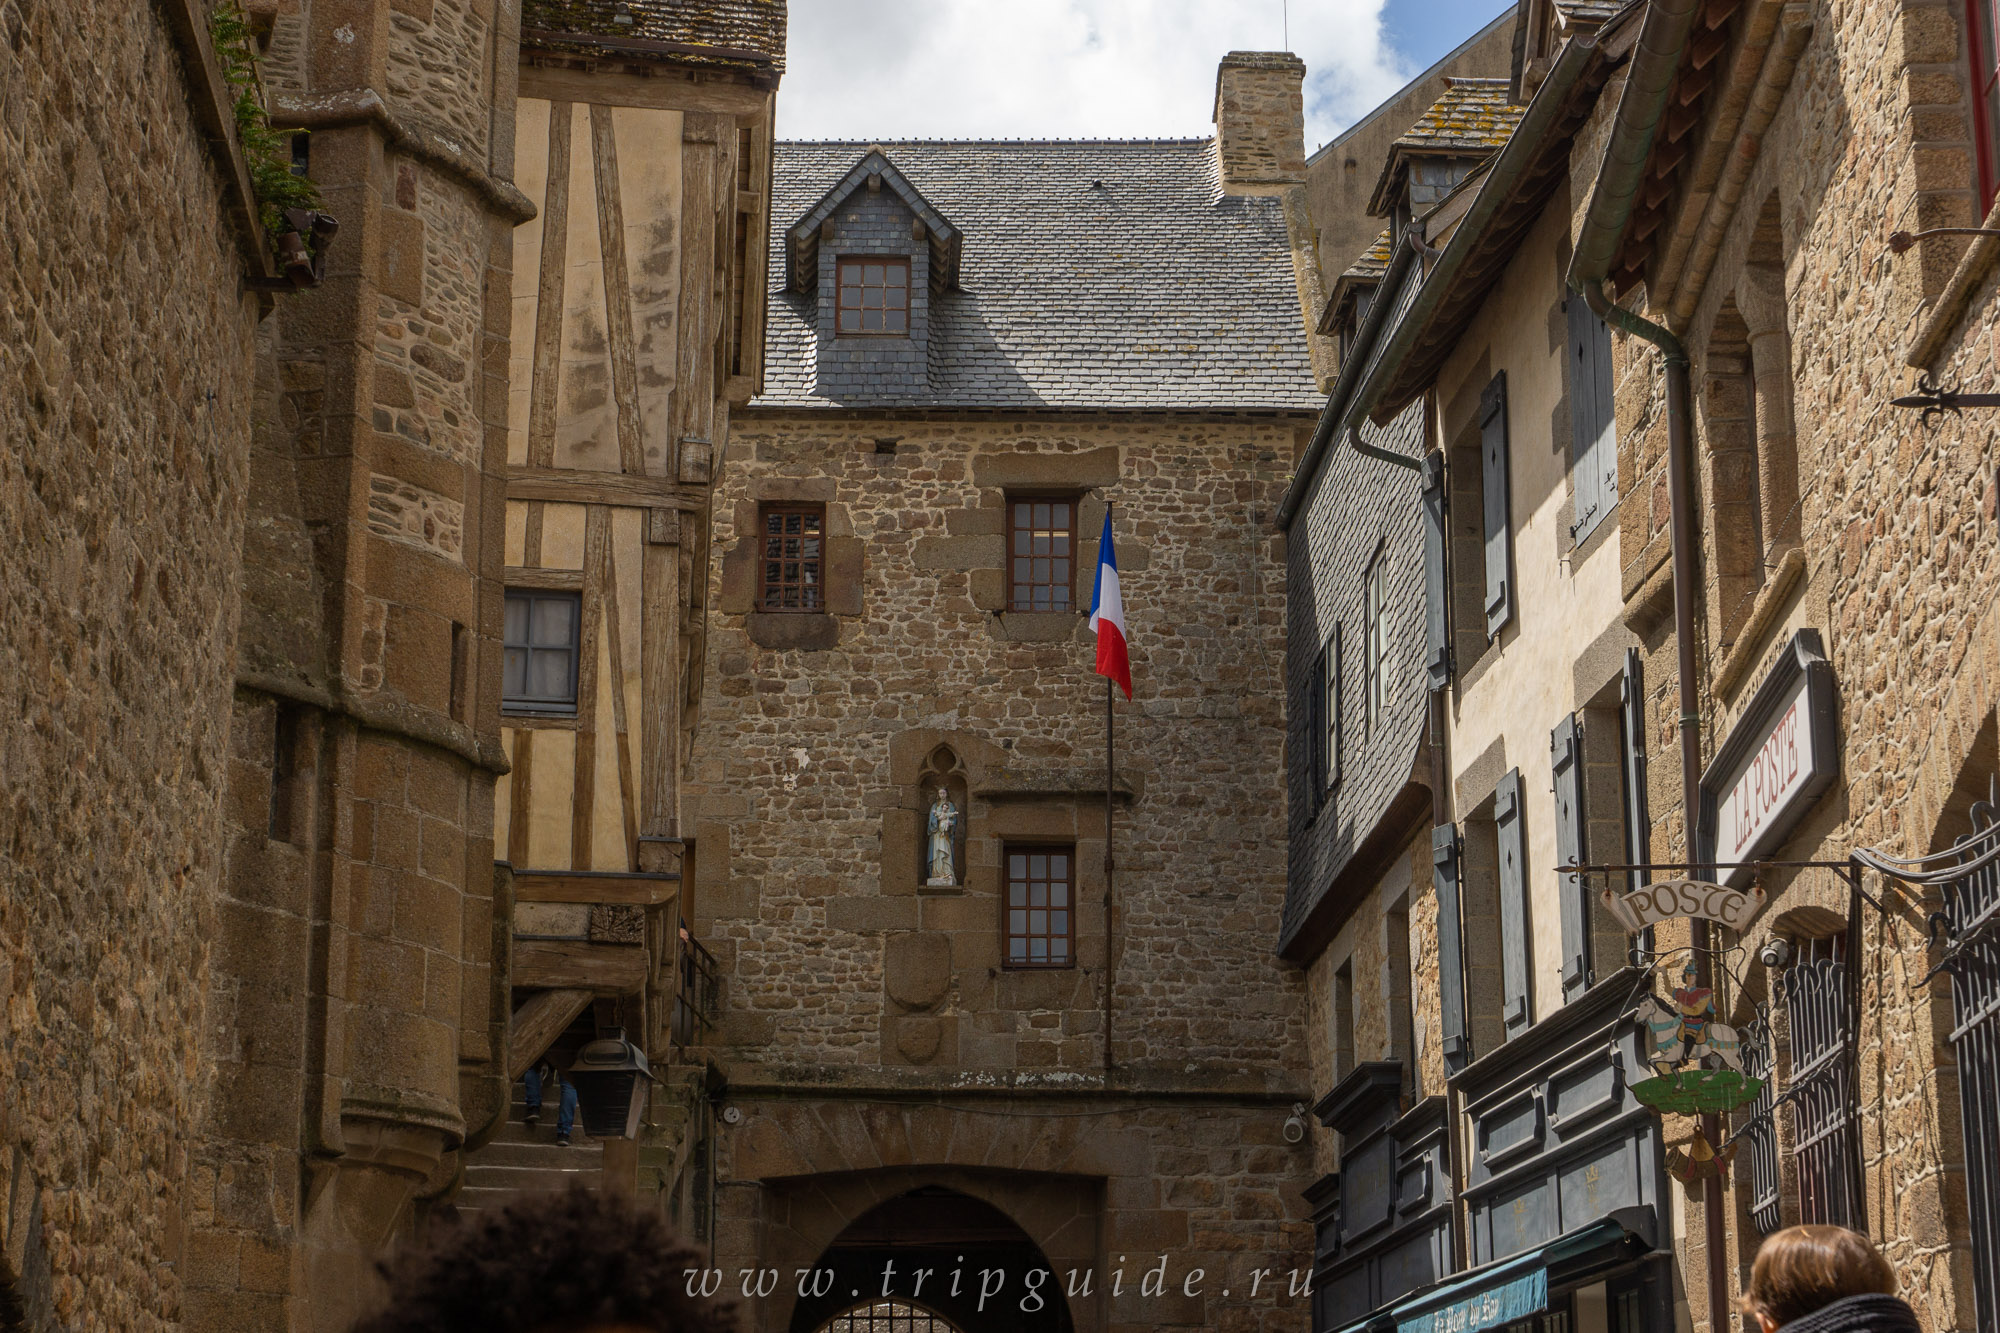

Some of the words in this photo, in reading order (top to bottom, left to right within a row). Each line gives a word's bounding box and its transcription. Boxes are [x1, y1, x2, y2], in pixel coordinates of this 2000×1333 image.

[1733, 773, 1753, 855] LA
[1753, 703, 1798, 828] POSTE
[1624, 882, 1747, 928] POSTE
